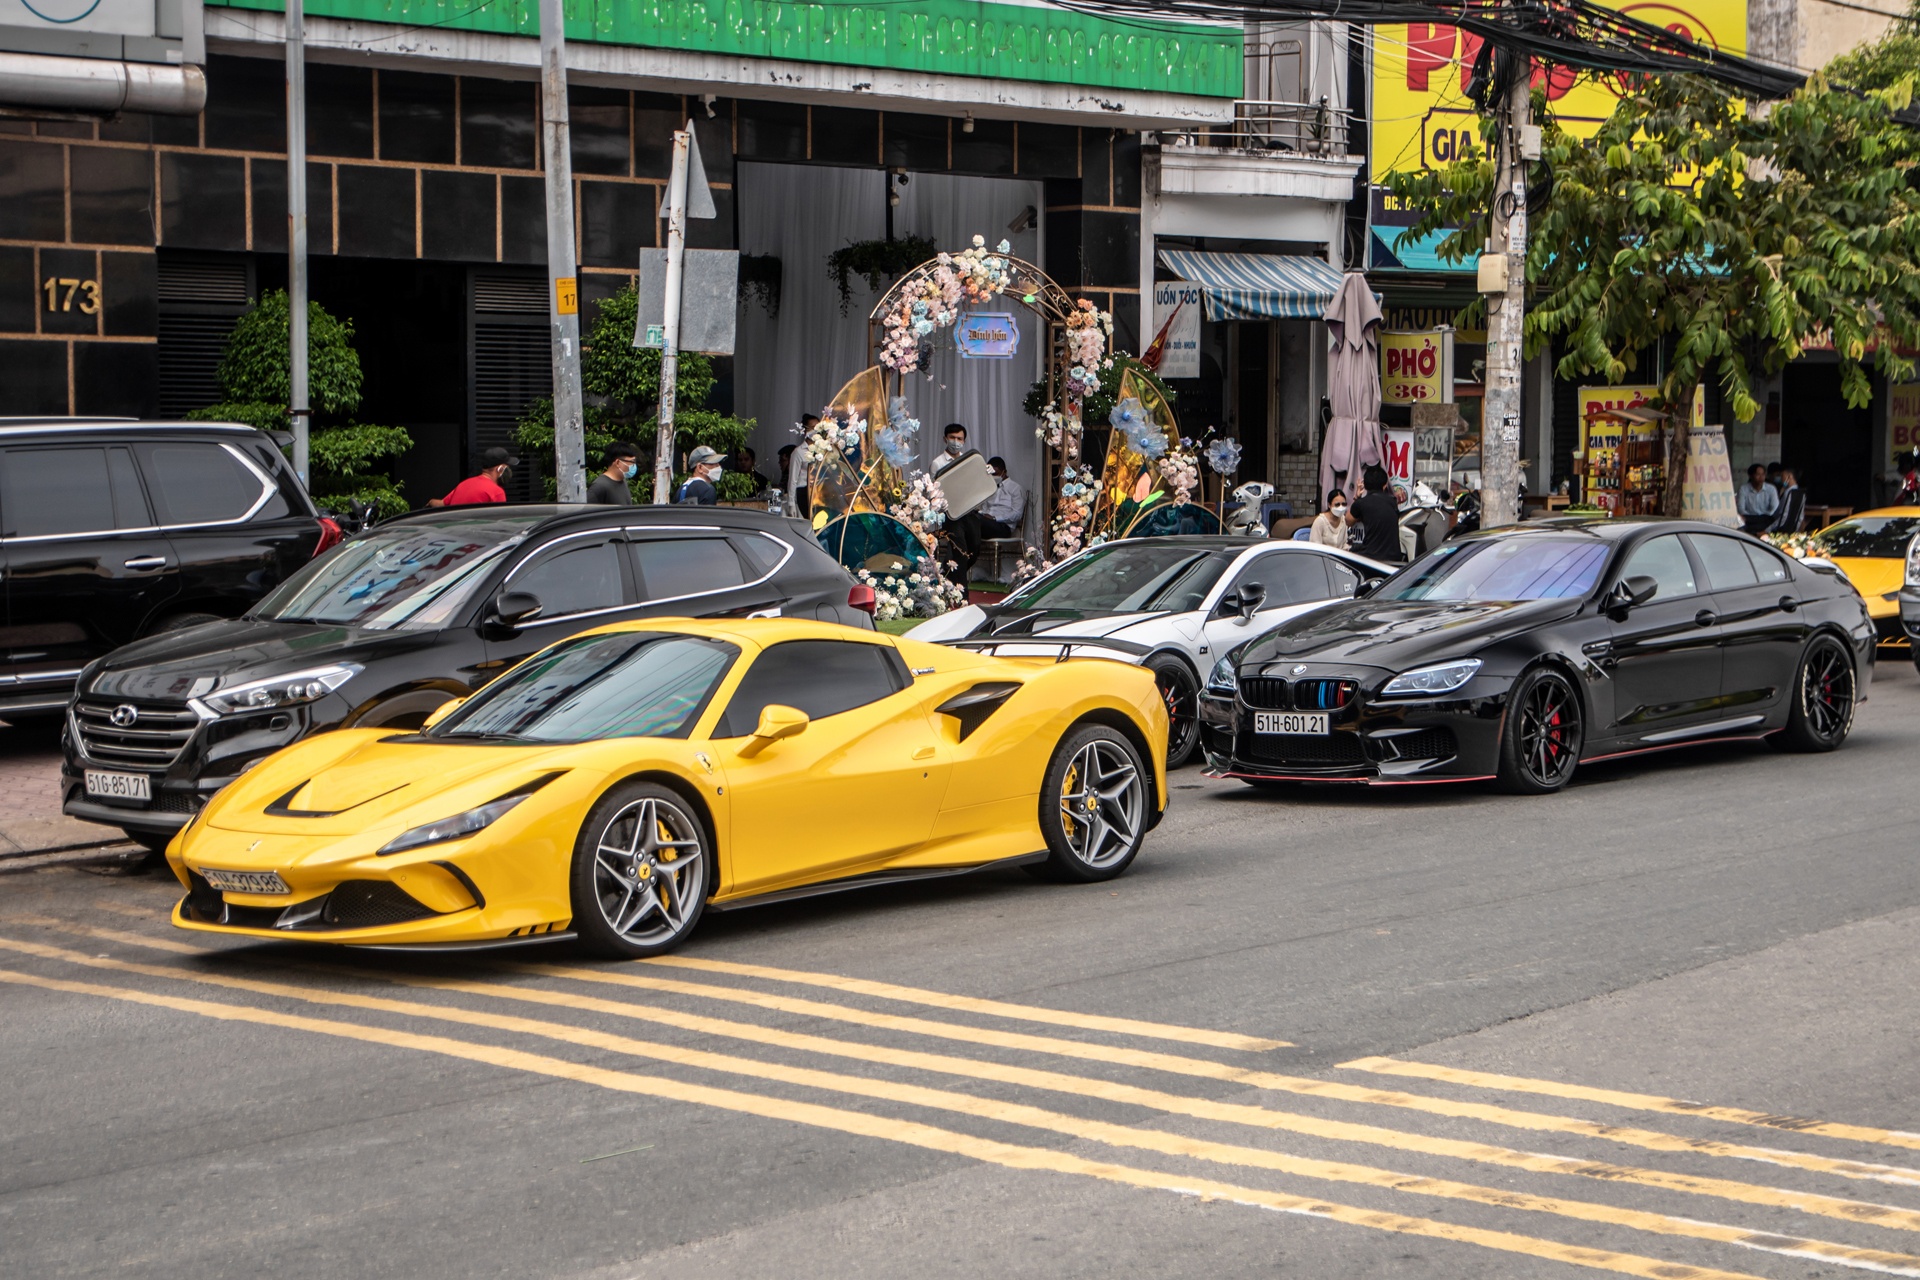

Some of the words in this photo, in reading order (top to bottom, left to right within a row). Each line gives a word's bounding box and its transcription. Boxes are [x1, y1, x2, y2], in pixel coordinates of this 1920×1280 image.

[44, 276, 101, 315] 173
[1156, 284, 1176, 305] UỐN
[1178, 286, 1198, 305] TÓC
[1386, 338, 1438, 379] PHỞ
[1395, 384, 1427, 400] 36
[1589, 435, 1604, 449] GIA
[1257, 714, 1325, 733] 51H-601.21
[87, 773, 149, 798] 51G-851.71
